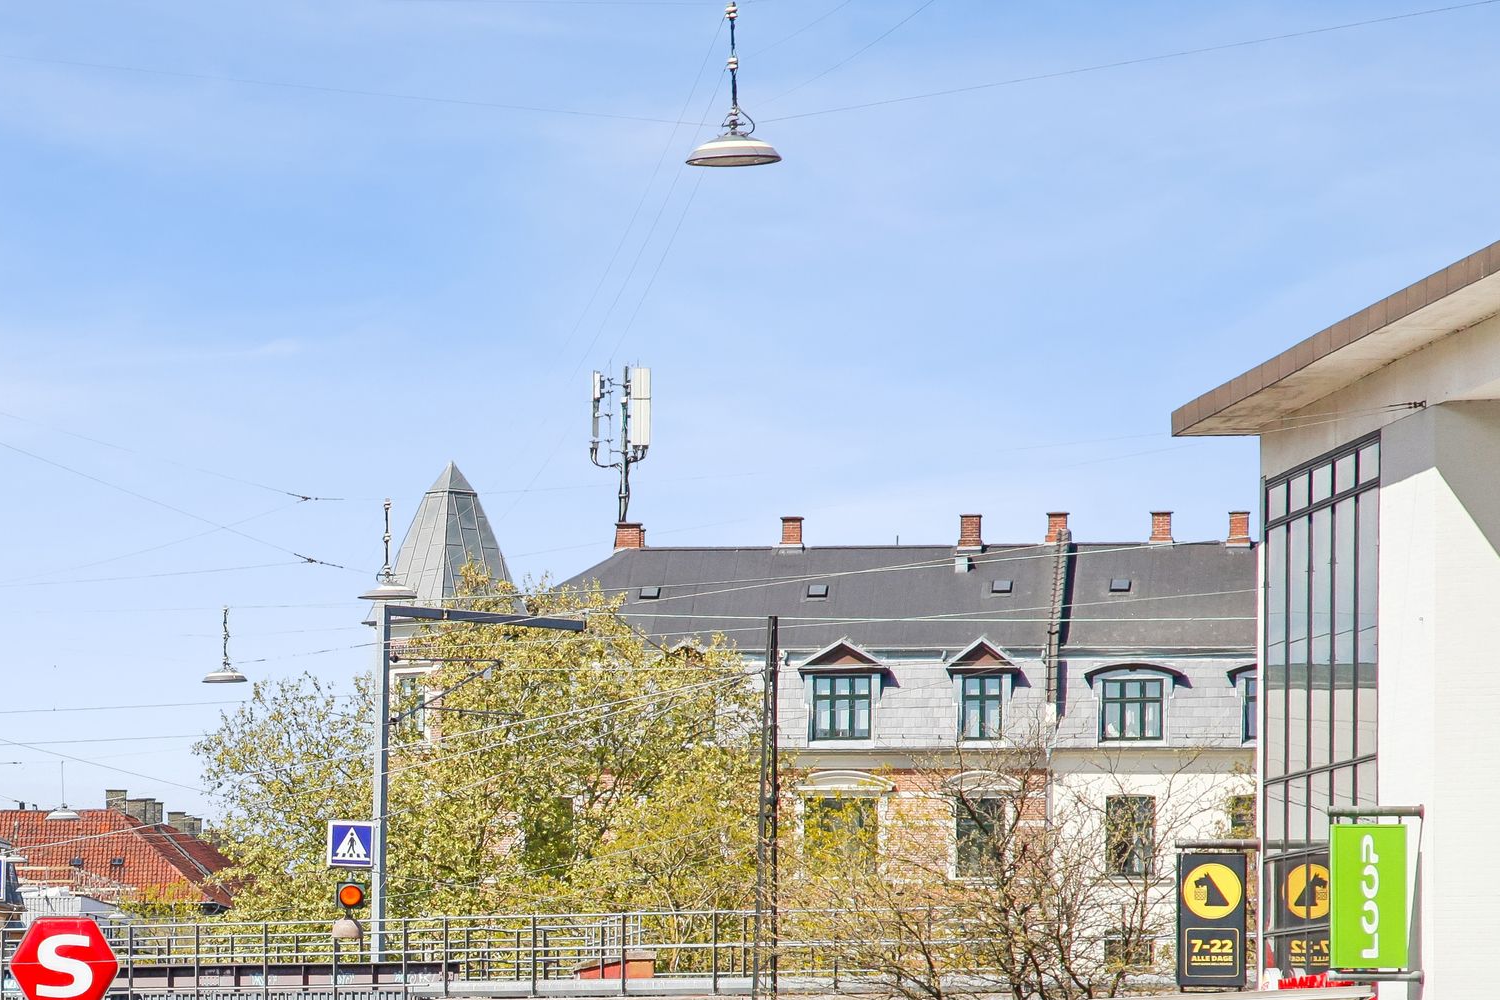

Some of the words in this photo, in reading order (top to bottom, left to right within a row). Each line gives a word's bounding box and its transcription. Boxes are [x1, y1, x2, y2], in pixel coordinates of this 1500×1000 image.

[1362, 834, 1379, 959] LOOP
[36, 934, 94, 998] S
[1191, 940, 1233, 953] 7-22
